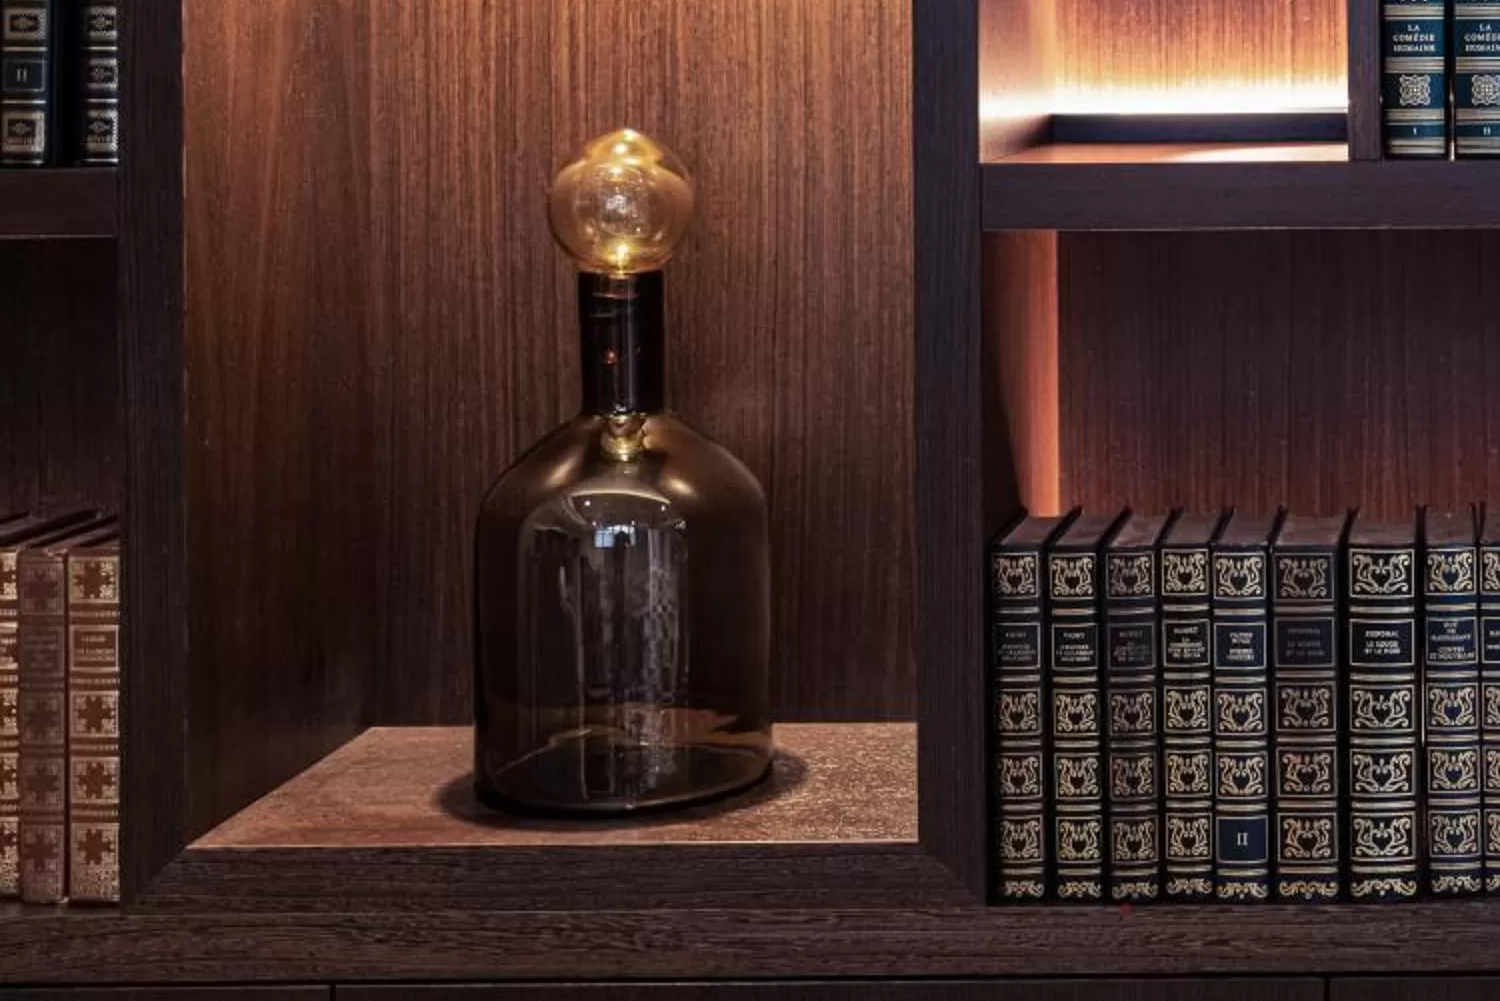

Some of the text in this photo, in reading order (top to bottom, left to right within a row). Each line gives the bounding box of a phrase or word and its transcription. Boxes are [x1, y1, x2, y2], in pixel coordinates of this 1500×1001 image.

[1407, 24, 1421, 32] LA
[1479, 23, 1492, 32] LA
[1392, 32, 1435, 43] COMÉDIE
